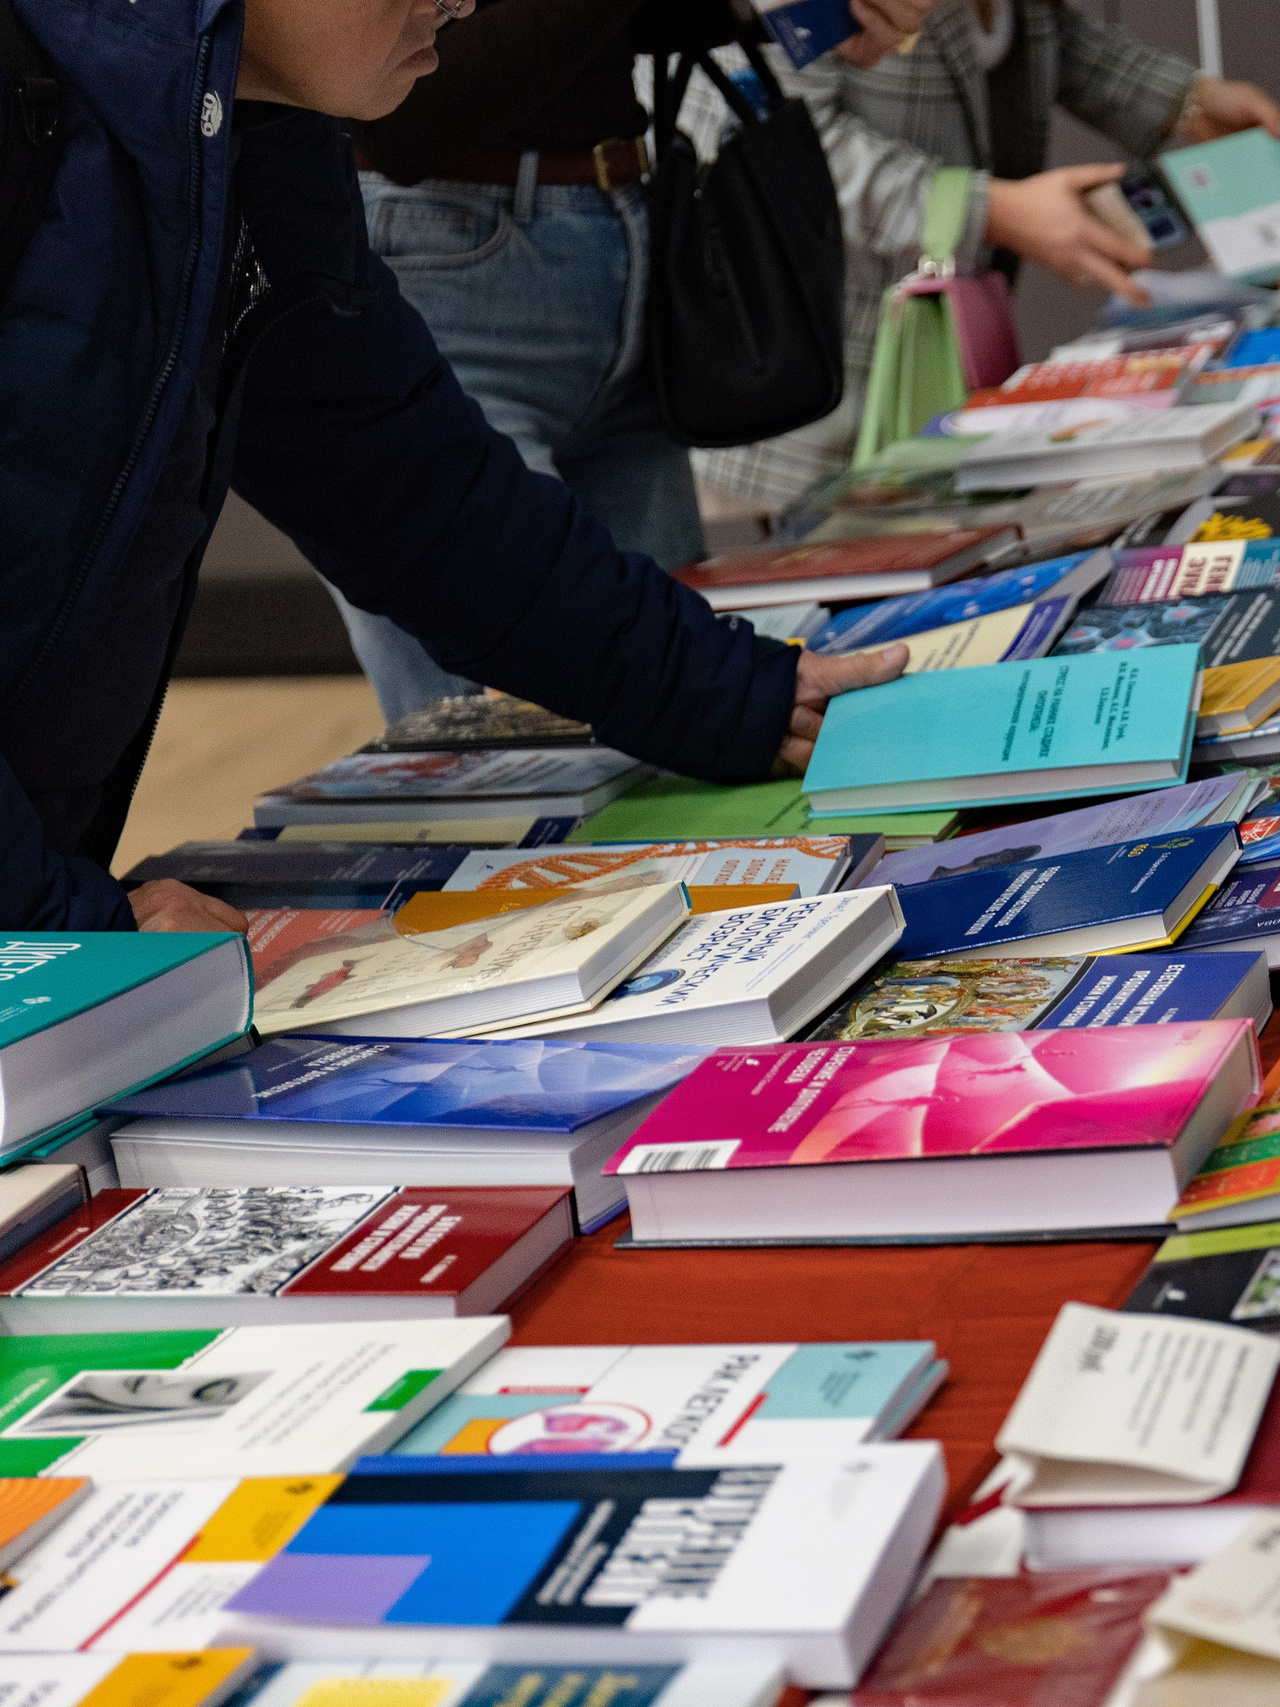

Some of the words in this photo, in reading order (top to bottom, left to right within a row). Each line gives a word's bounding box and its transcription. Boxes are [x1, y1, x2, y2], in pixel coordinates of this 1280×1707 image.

[677, 911, 755, 964] ВОЗРАСТ
[731, 900, 823, 965] РЕАЛЬНЫЙ
[0, 941, 81, 980] ДИЕТ
[652, 905, 789, 1008] БИОЛОГИЧЕСКИЙ
[1135, 963, 1186, 1004] ЕСТЕСТВЕННАЯ
[325, 1045, 393, 1066] СТАРЕНИЕ
[811, 1045, 856, 1080] СТАРЕНИЕ
